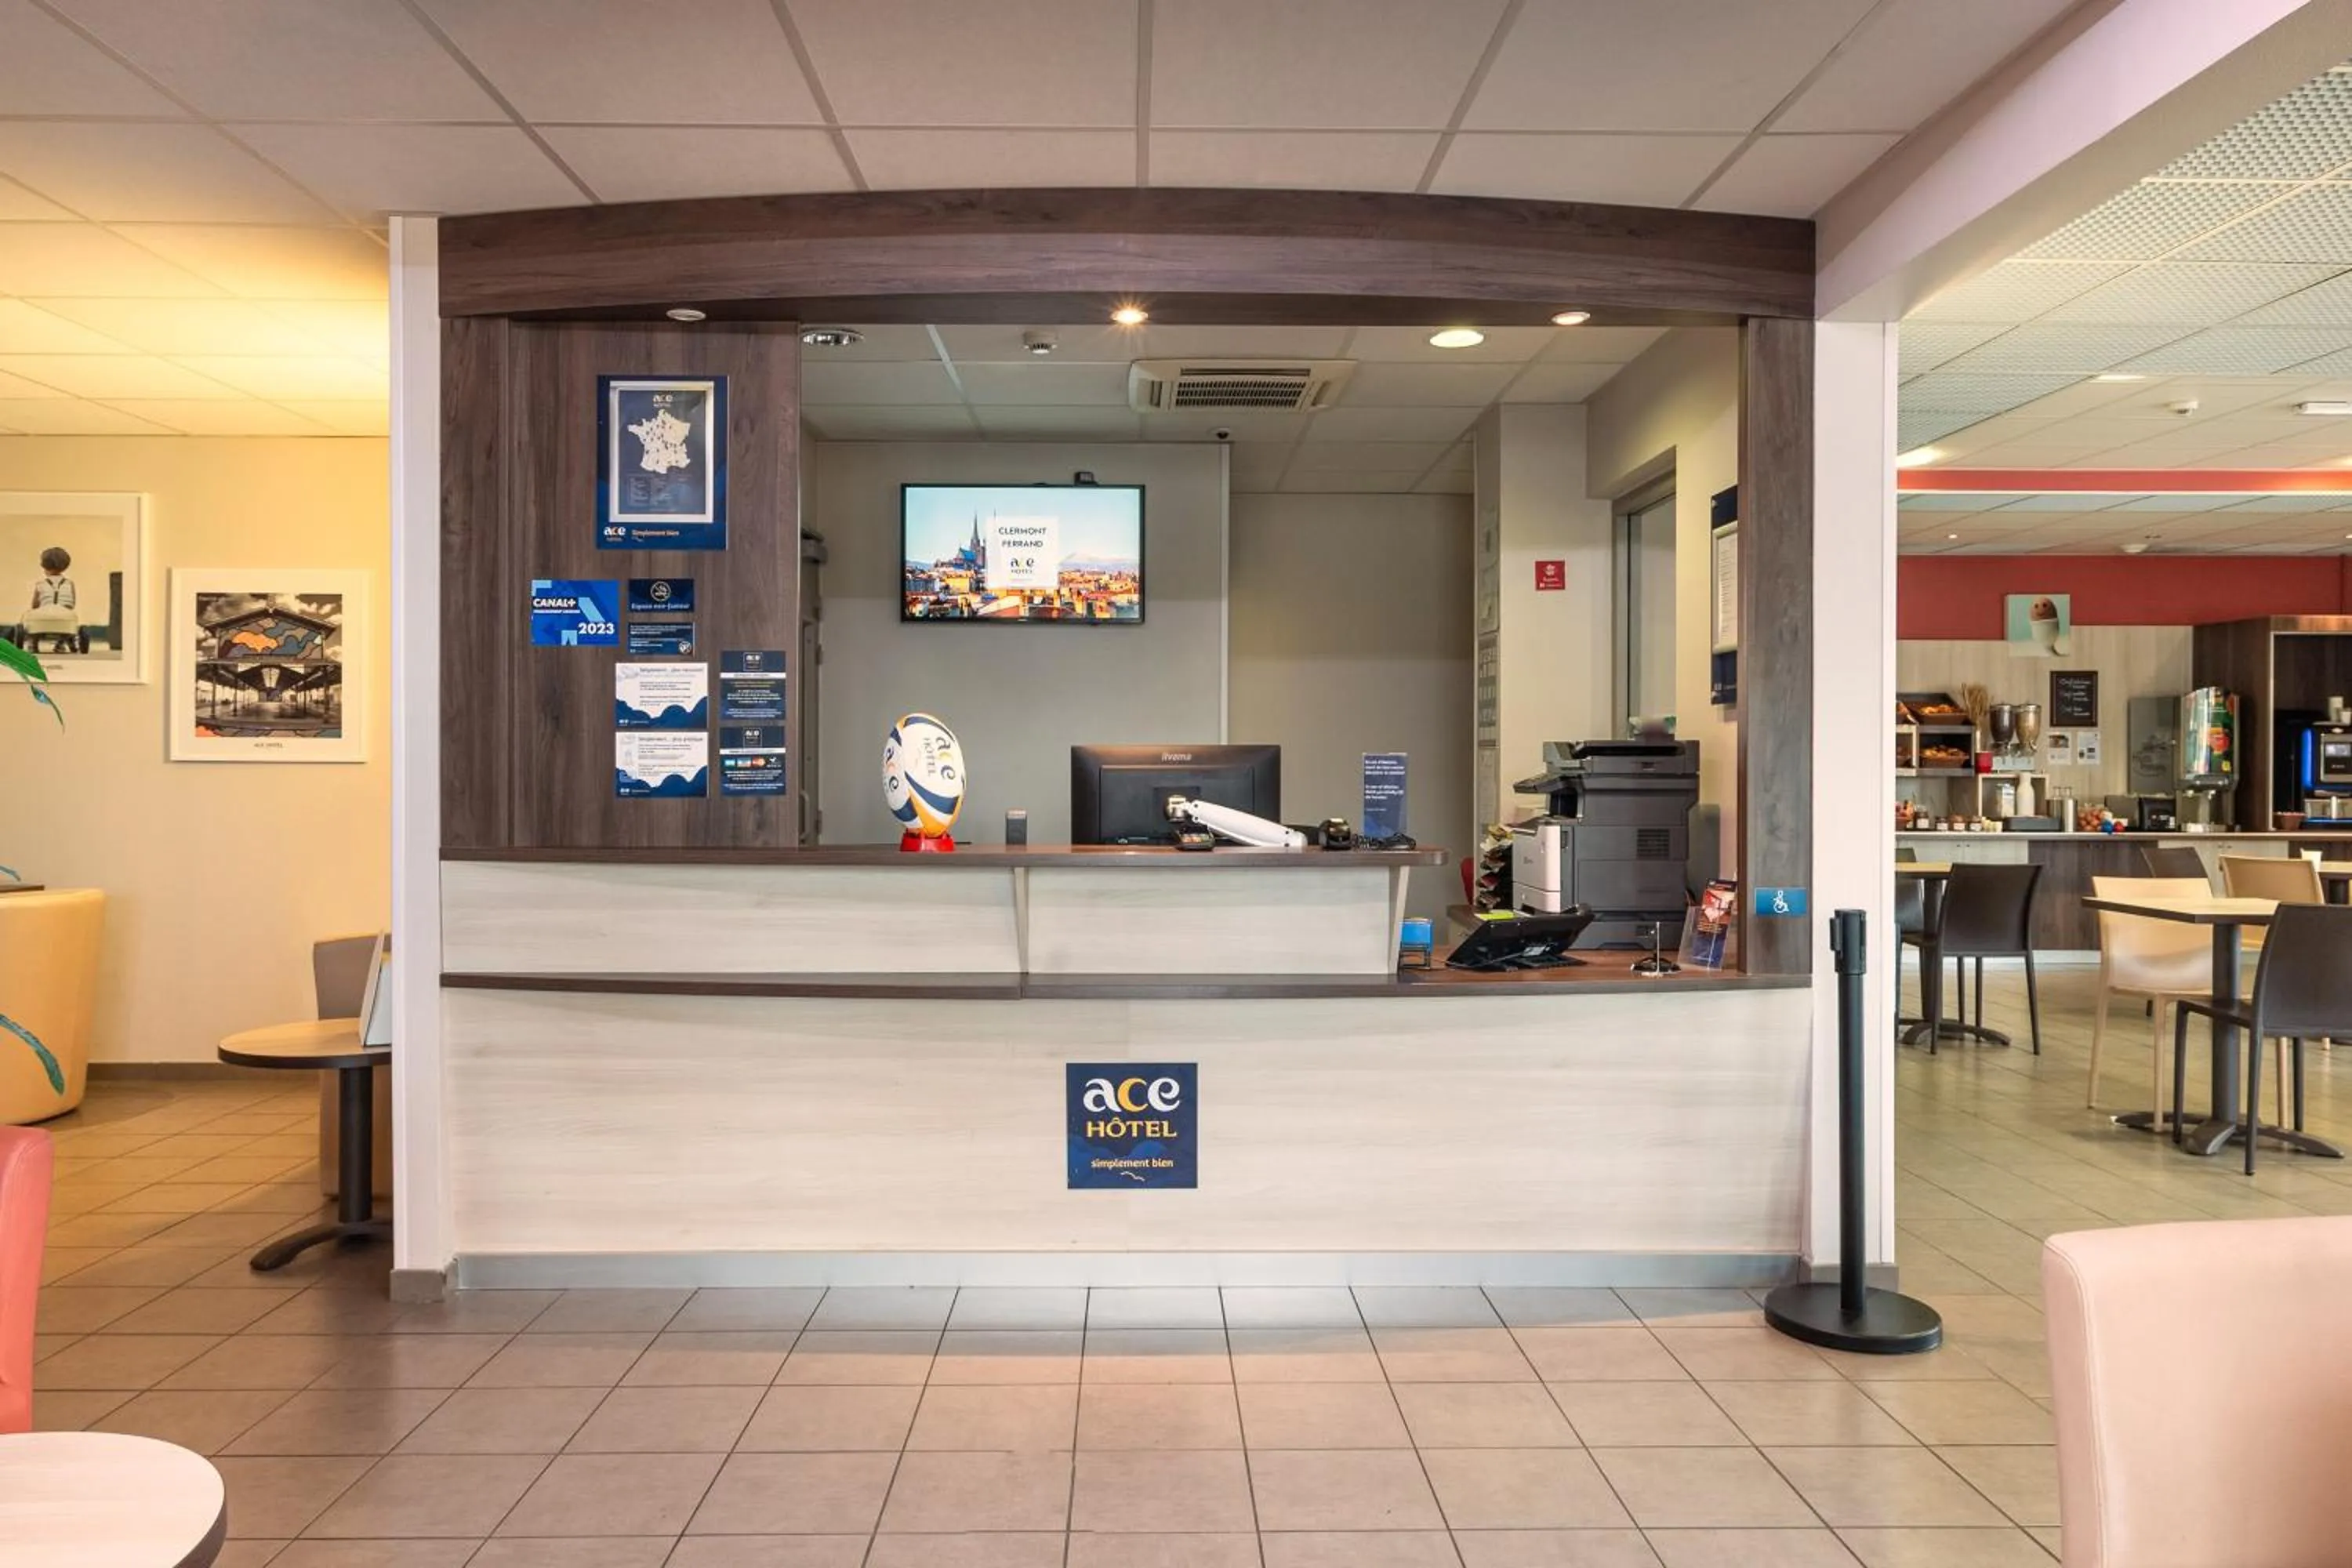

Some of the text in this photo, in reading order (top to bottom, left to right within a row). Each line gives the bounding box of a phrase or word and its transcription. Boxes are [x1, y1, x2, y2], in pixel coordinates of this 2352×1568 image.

[603, 527, 626, 535] ace
[998, 527, 1047, 535] CLERMONT
[533, 598, 576, 608] CANAL+
[578, 622, 615, 634] 2023
[935, 737, 956, 780] ace
[1083, 1077, 1180, 1112] ace
[1086, 1116, 1178, 1138] HÔTEL
[1091, 1158, 1174, 1171] simplement bien
